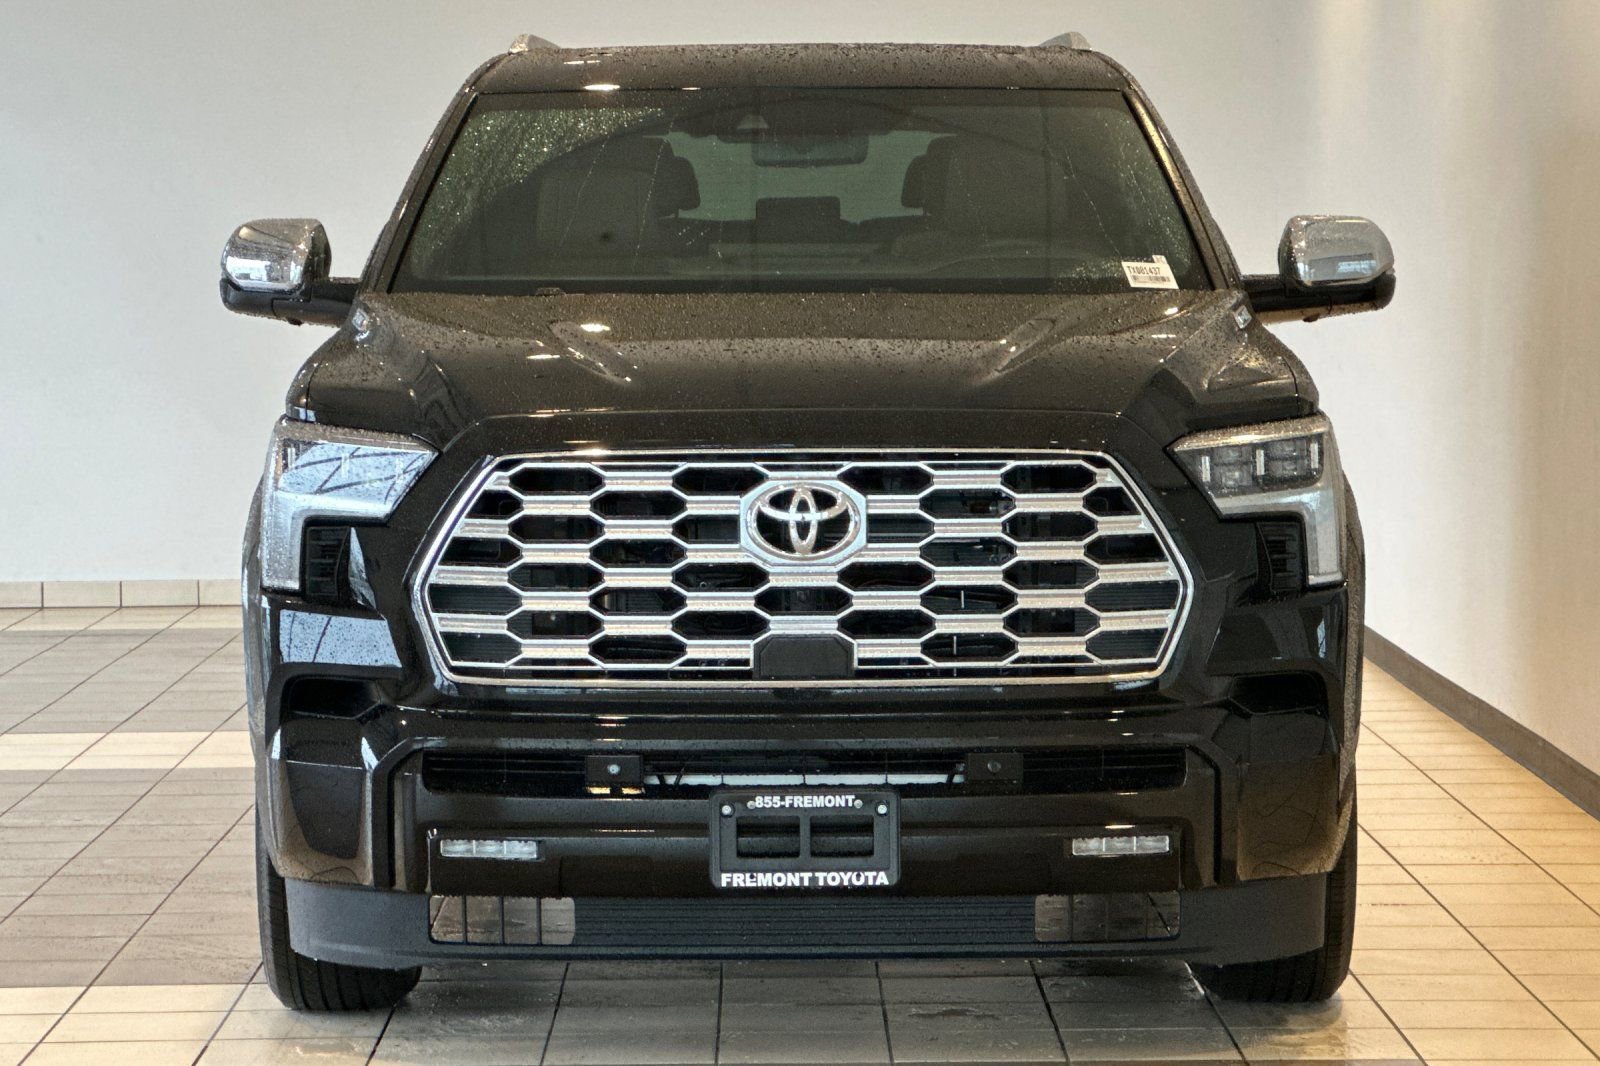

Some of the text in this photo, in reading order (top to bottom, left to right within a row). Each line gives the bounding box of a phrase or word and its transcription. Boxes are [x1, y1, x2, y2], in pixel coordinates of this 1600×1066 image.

[755, 795, 855, 808] 855-FREMONT
[721, 872, 889, 888] FREMONT TOYOTA
